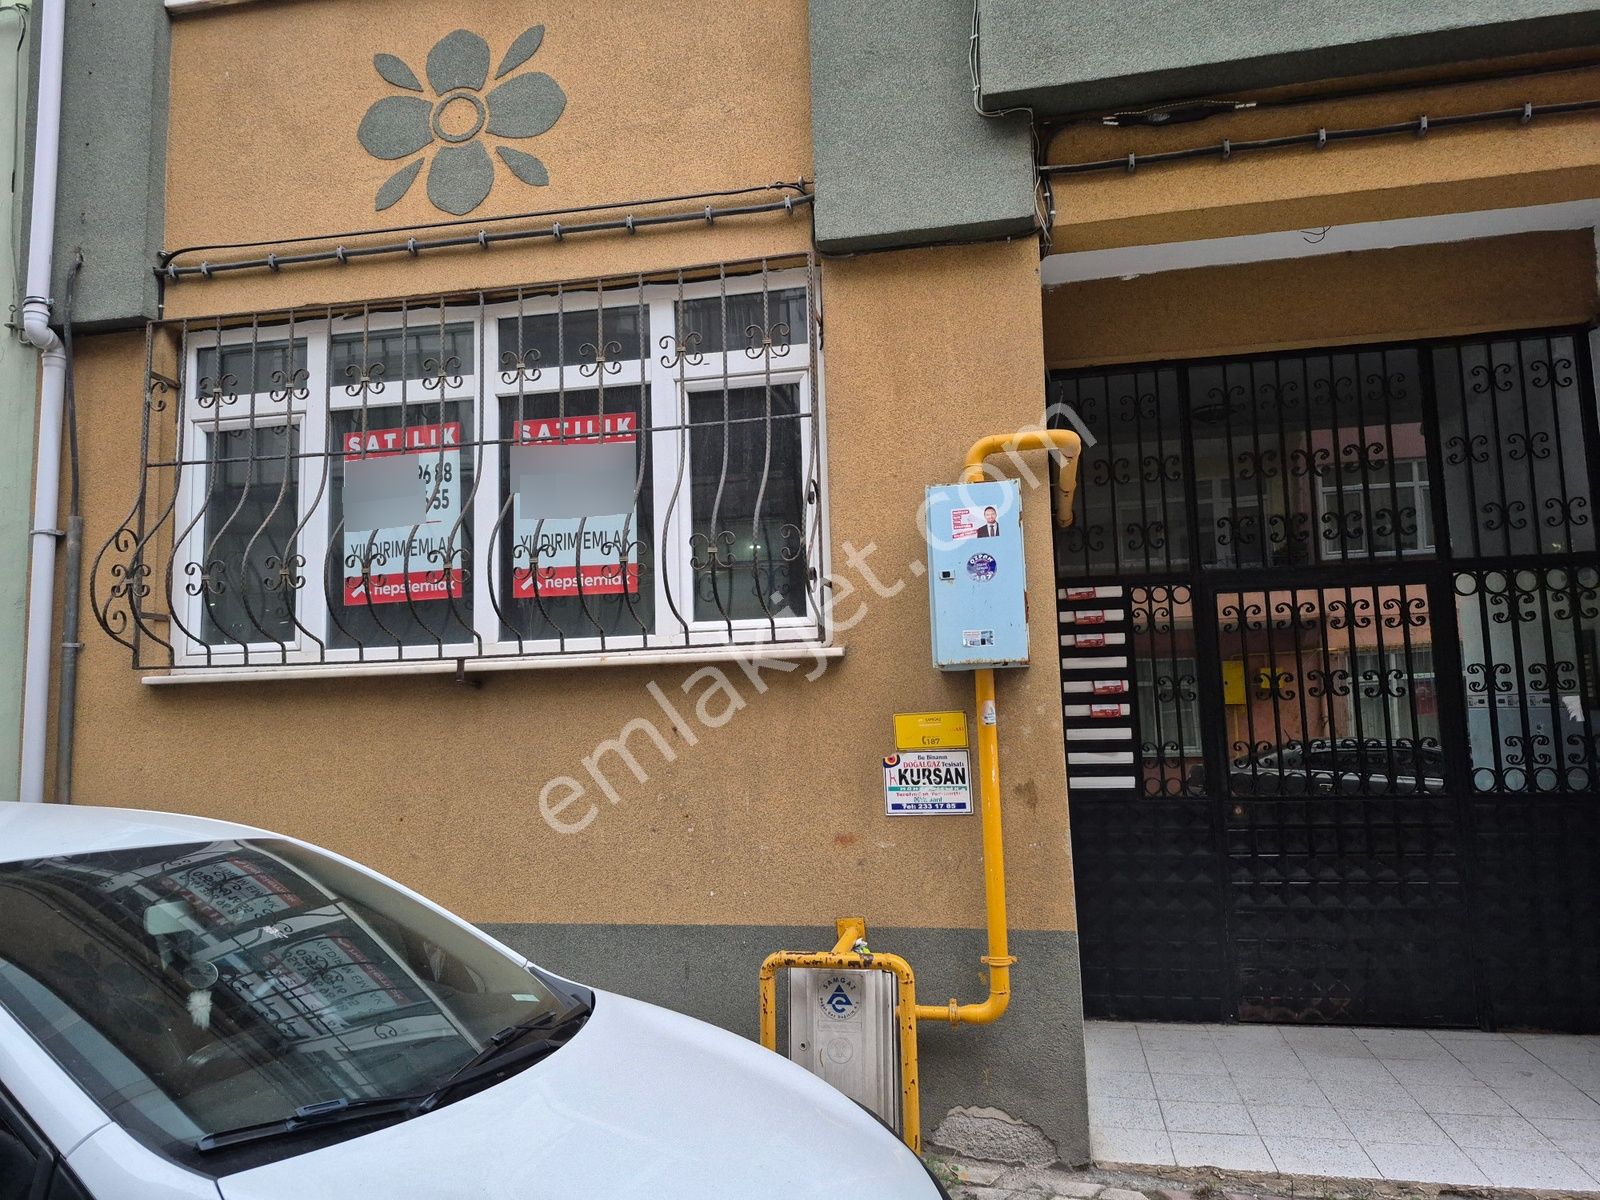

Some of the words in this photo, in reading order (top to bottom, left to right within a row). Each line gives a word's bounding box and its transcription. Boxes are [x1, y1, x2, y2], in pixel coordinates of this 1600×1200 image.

[521, 417, 632, 445] SATILIK
[926, 737, 940, 745] 187
[898, 767, 966, 786] KURSAN
[823, 976, 856, 990] SAMGAZ
